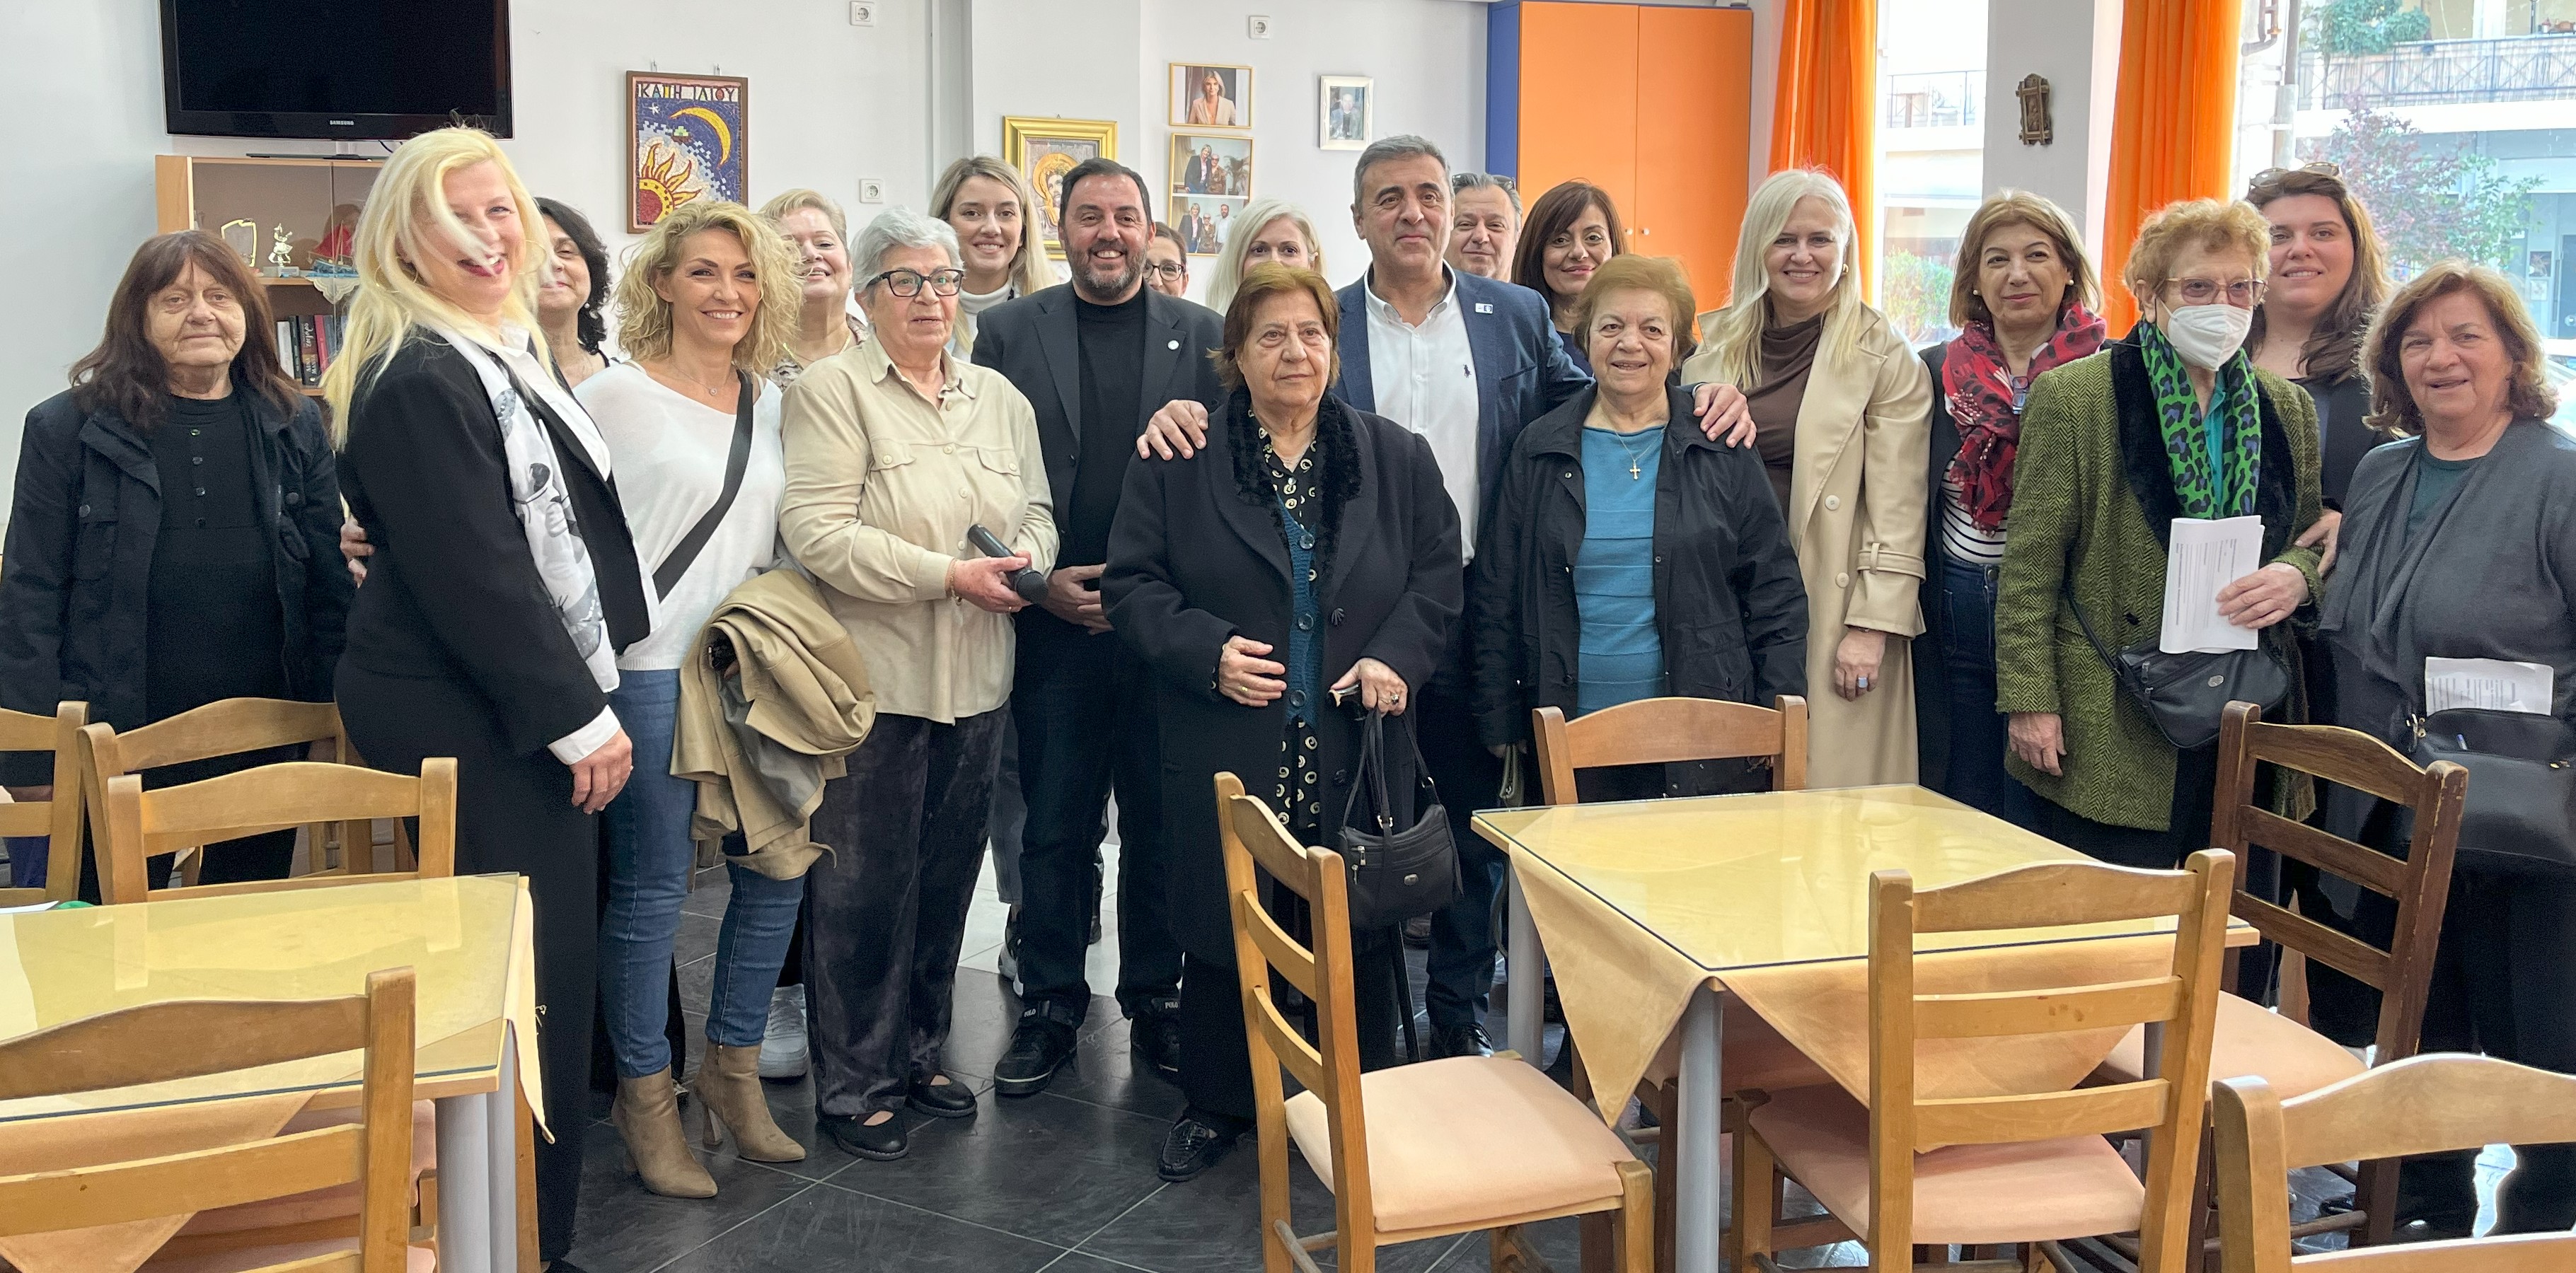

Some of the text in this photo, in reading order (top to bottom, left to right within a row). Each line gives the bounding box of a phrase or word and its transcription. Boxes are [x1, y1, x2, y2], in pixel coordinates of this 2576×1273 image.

[640, 83, 735, 102] ΚΑΠΗ ΙΛΙΟΥ
[1024, 1008, 1036, 1018] POLO
